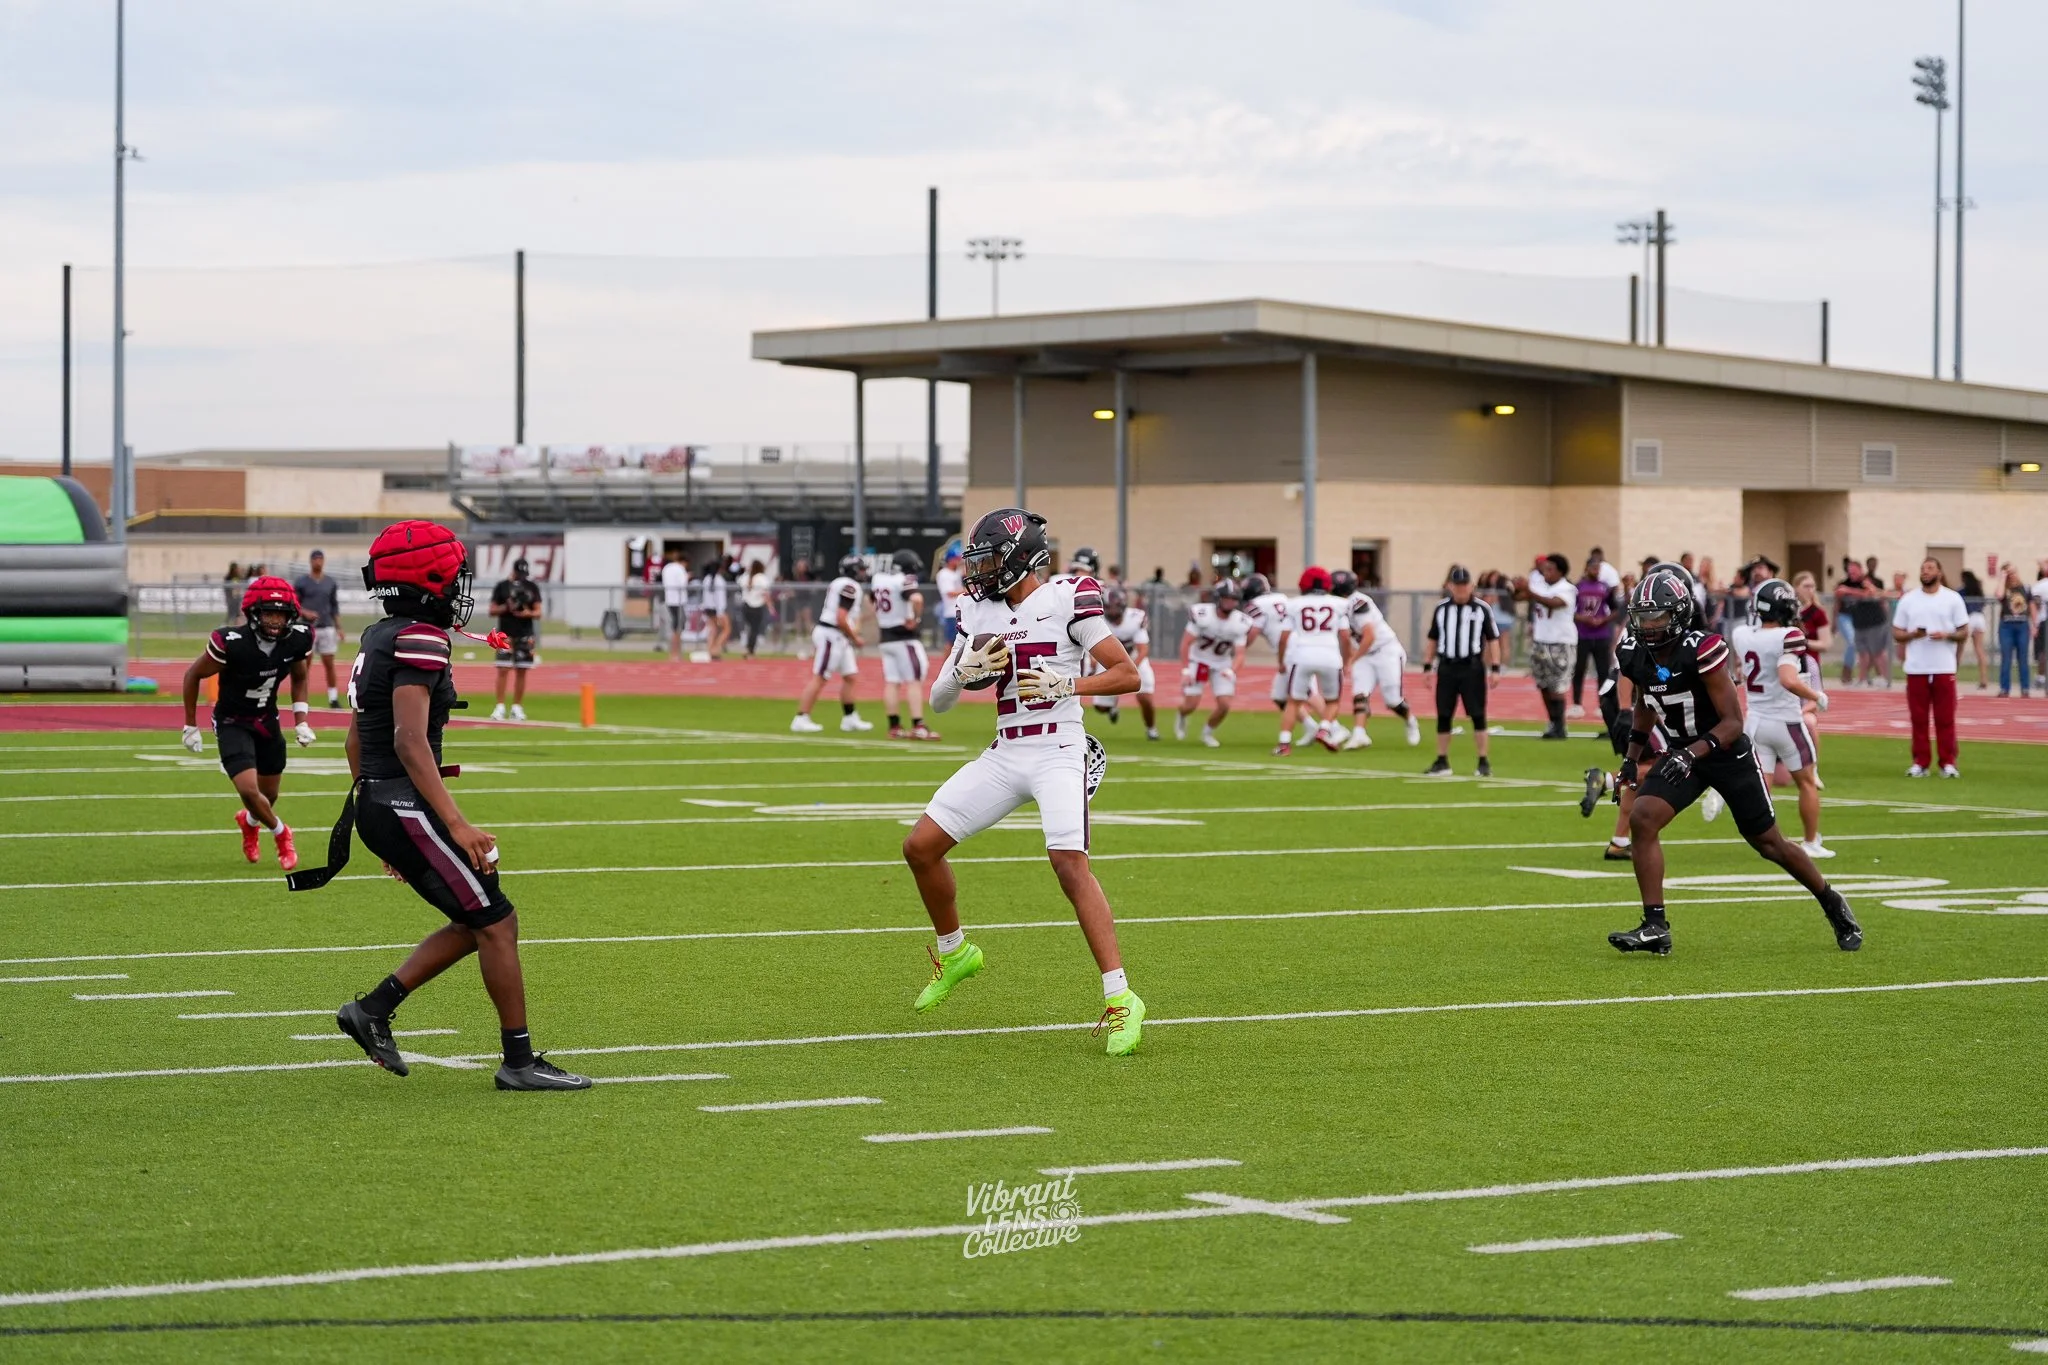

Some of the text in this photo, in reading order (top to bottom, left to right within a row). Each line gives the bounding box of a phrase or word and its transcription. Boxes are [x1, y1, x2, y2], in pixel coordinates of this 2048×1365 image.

[1000, 515, 1023, 535] W
[1301, 606, 1333, 631] 62
[1744, 650, 1764, 694] 2
[245, 676, 276, 708] 4
[1649, 684, 1668, 692] WEISS
